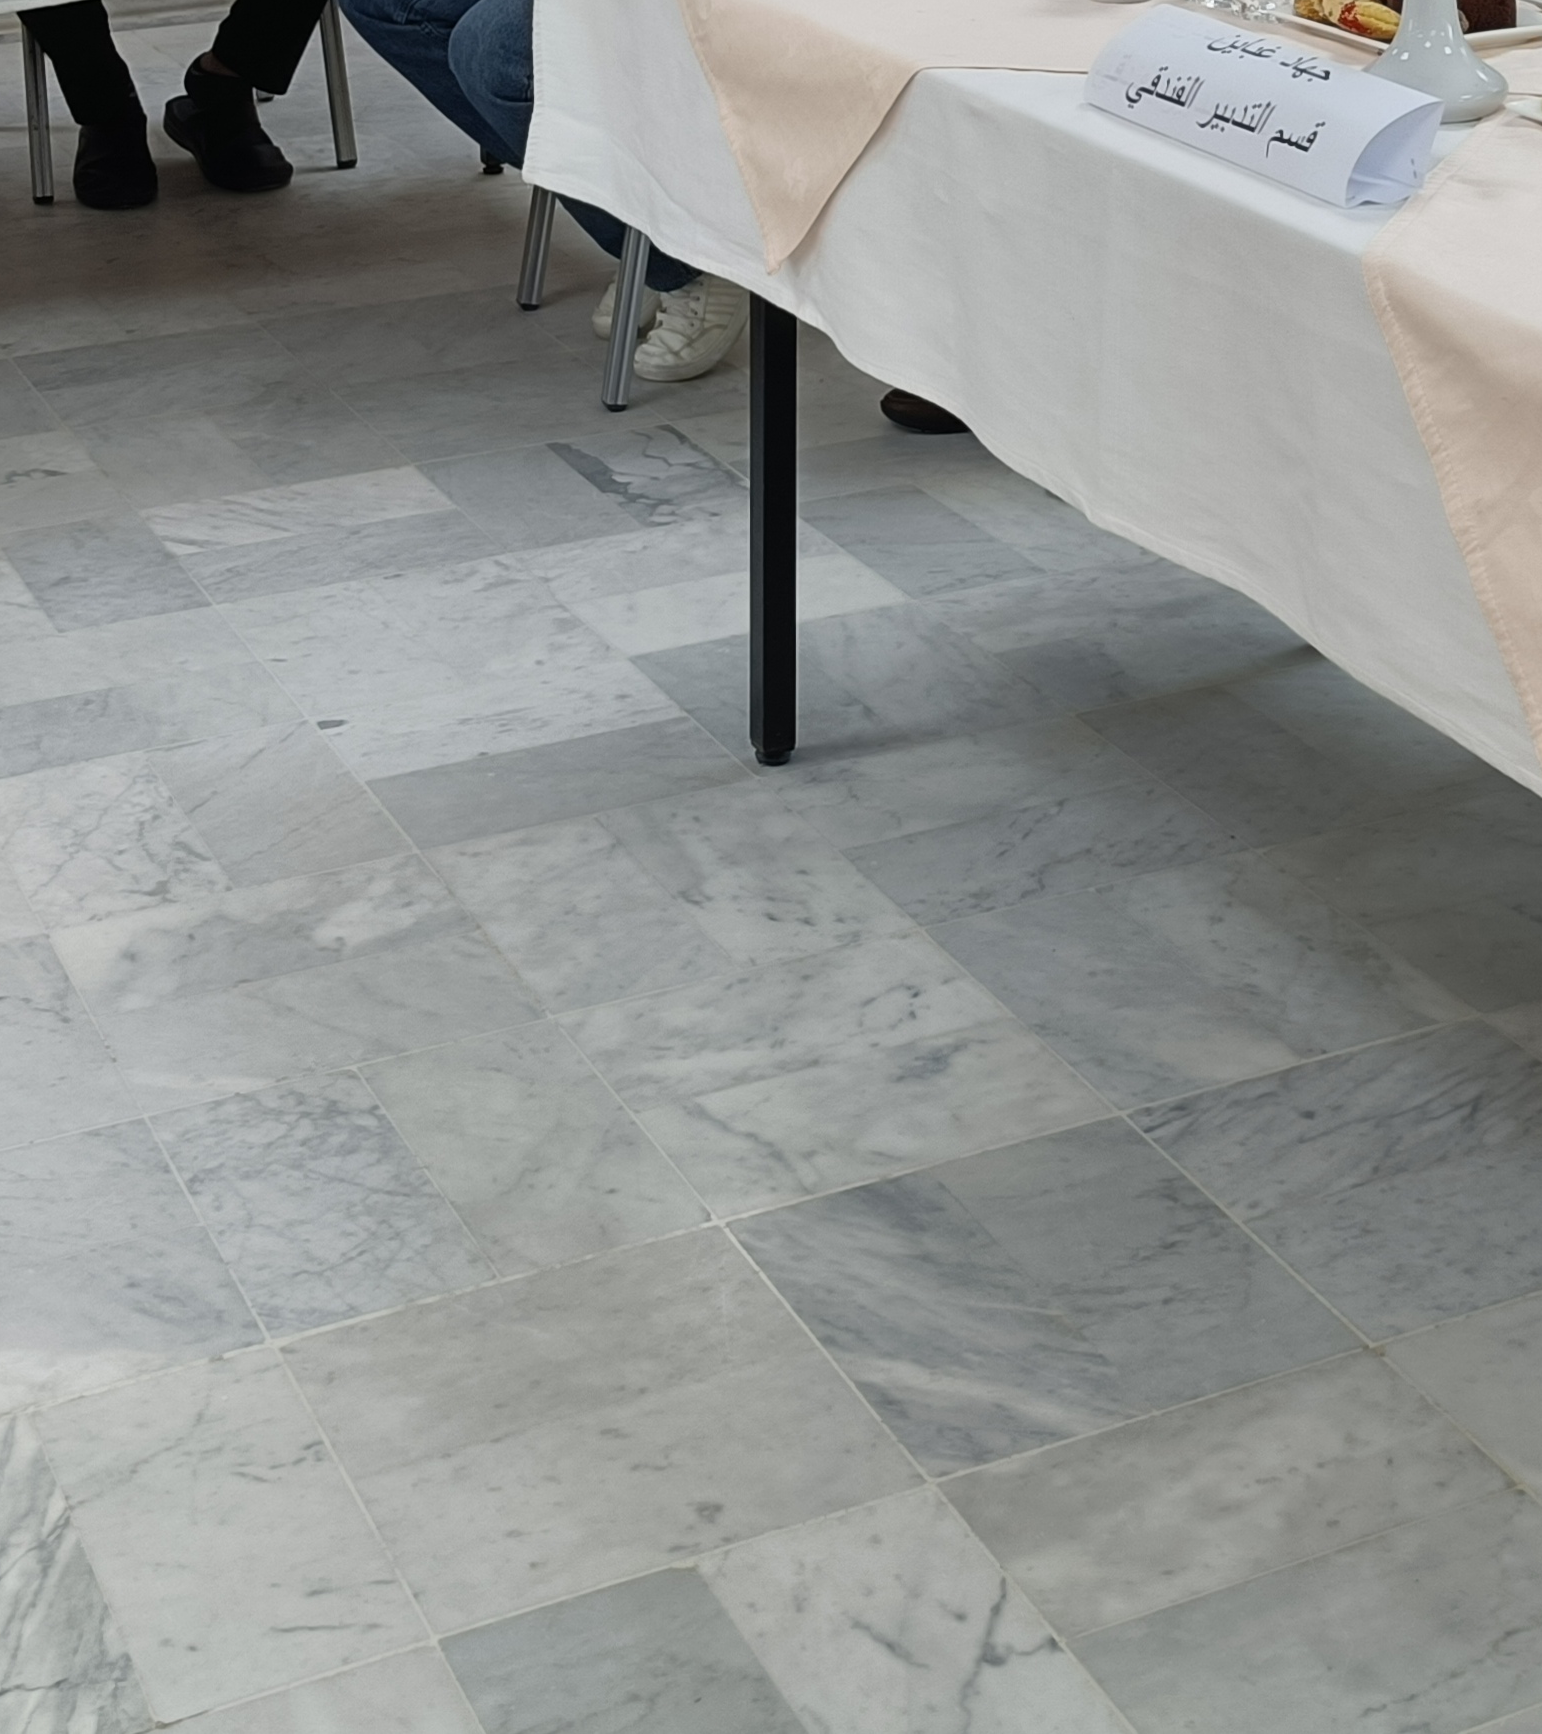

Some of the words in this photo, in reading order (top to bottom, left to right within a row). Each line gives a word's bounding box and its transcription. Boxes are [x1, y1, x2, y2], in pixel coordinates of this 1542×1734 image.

[1124, 65, 1206, 109] الفندقي
[1195, 100, 1278, 135] التدبير
[1265, 121, 1326, 159] قسم
